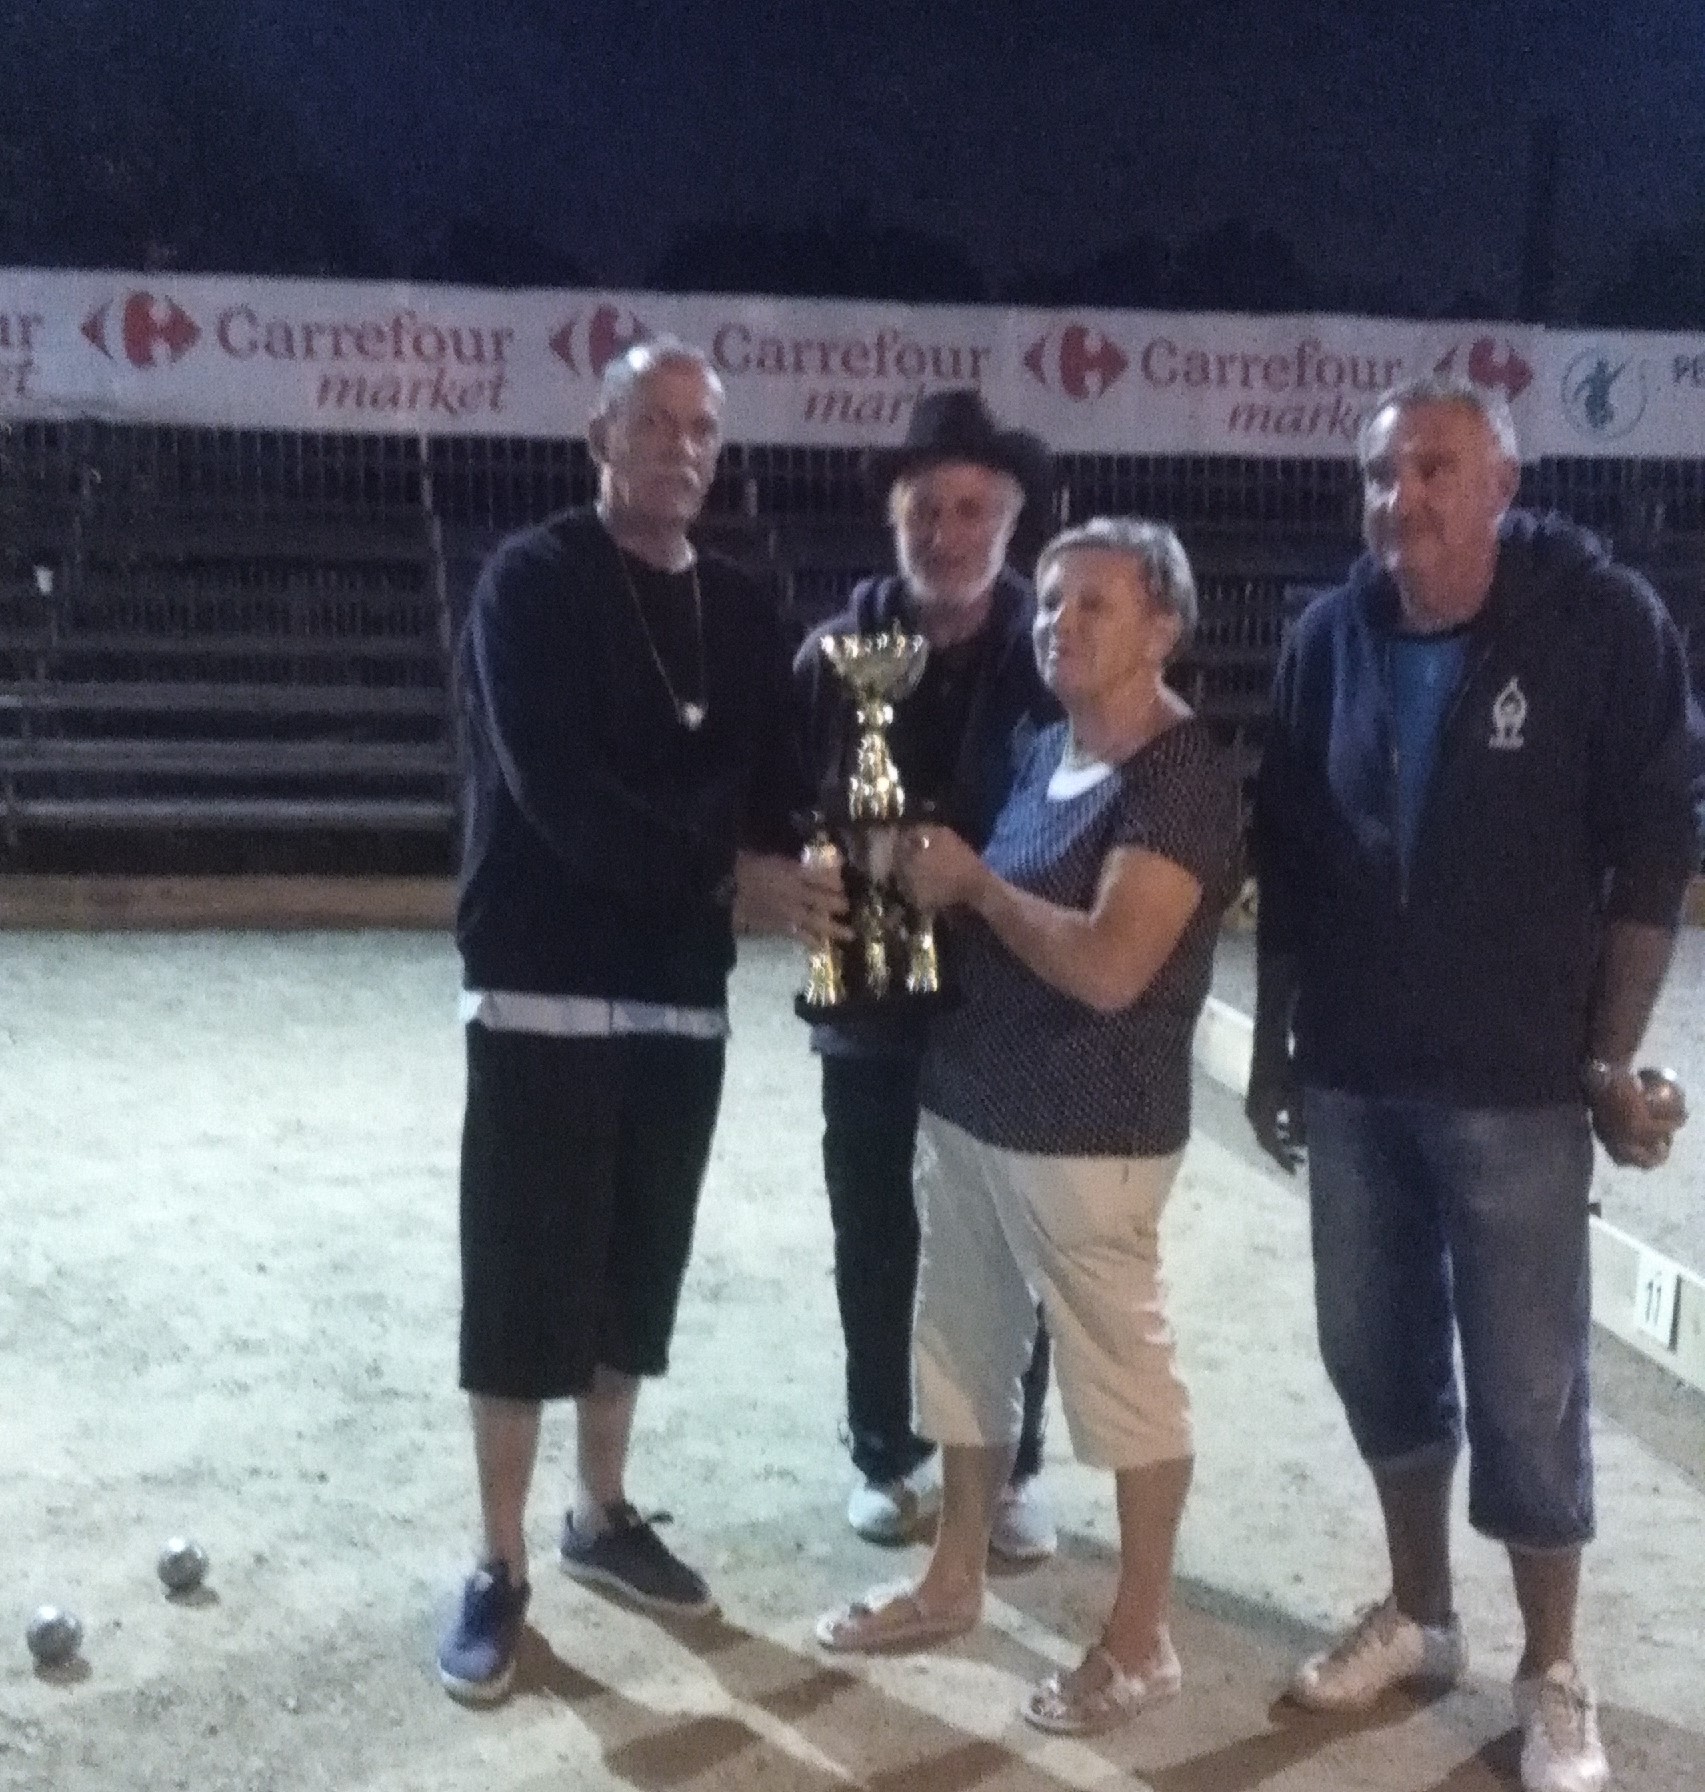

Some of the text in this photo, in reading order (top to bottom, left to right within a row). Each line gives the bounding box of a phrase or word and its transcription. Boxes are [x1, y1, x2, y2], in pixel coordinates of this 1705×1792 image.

[216, 304, 515, 366] Carrefour
[713, 322, 990, 381] Carrefour
[316, 364, 509, 415] market
[1140, 336, 1403, 392] Carrefour
